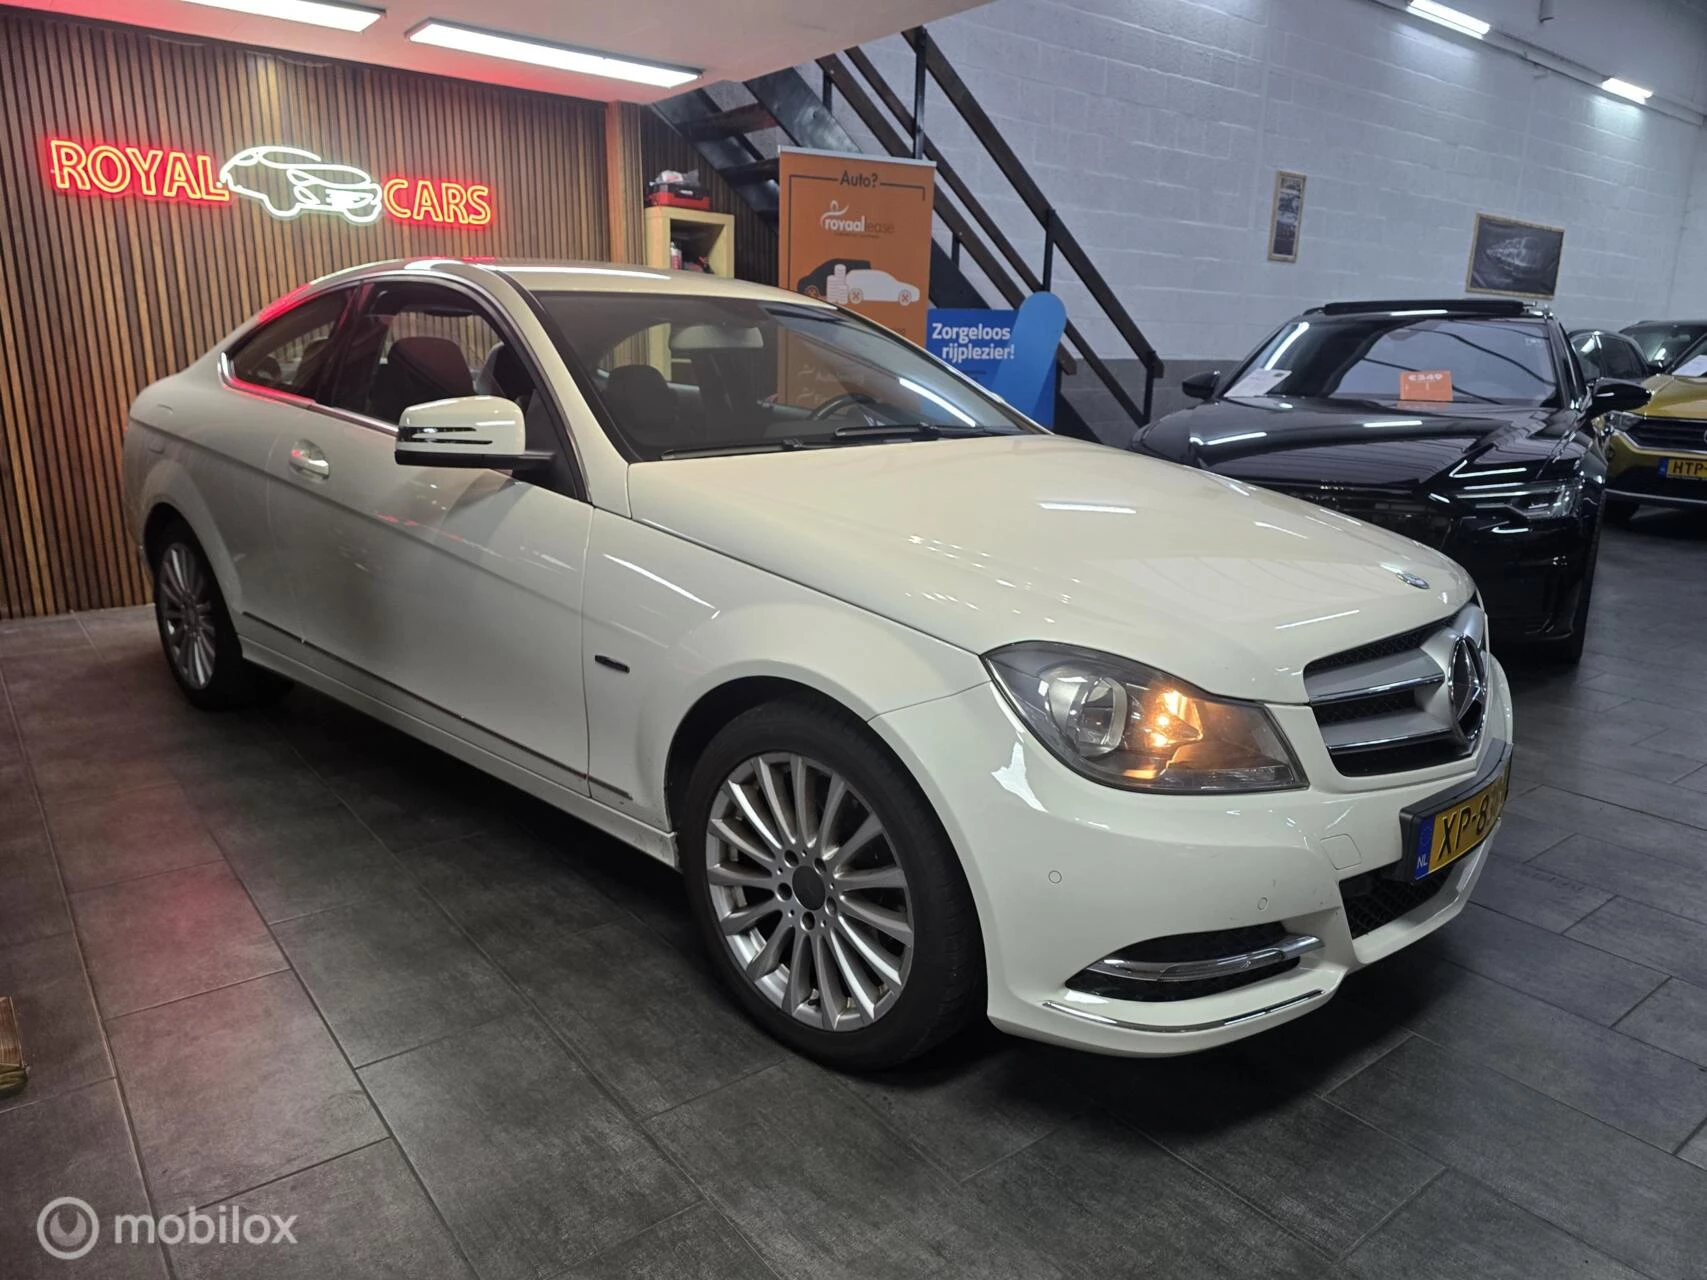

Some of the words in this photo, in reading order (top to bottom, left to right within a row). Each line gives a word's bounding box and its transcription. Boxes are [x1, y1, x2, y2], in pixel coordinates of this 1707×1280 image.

[50, 139, 230, 202] ROYAL
[383, 178, 492, 225] CARS
[840, 169, 879, 188] Auto?
[931, 322, 1011, 344] Zorgeloos
[942, 342, 1015, 364] rijplezier!
[1438, 781, 1500, 862] XP-8
[1417, 853, 1428, 869] NL
